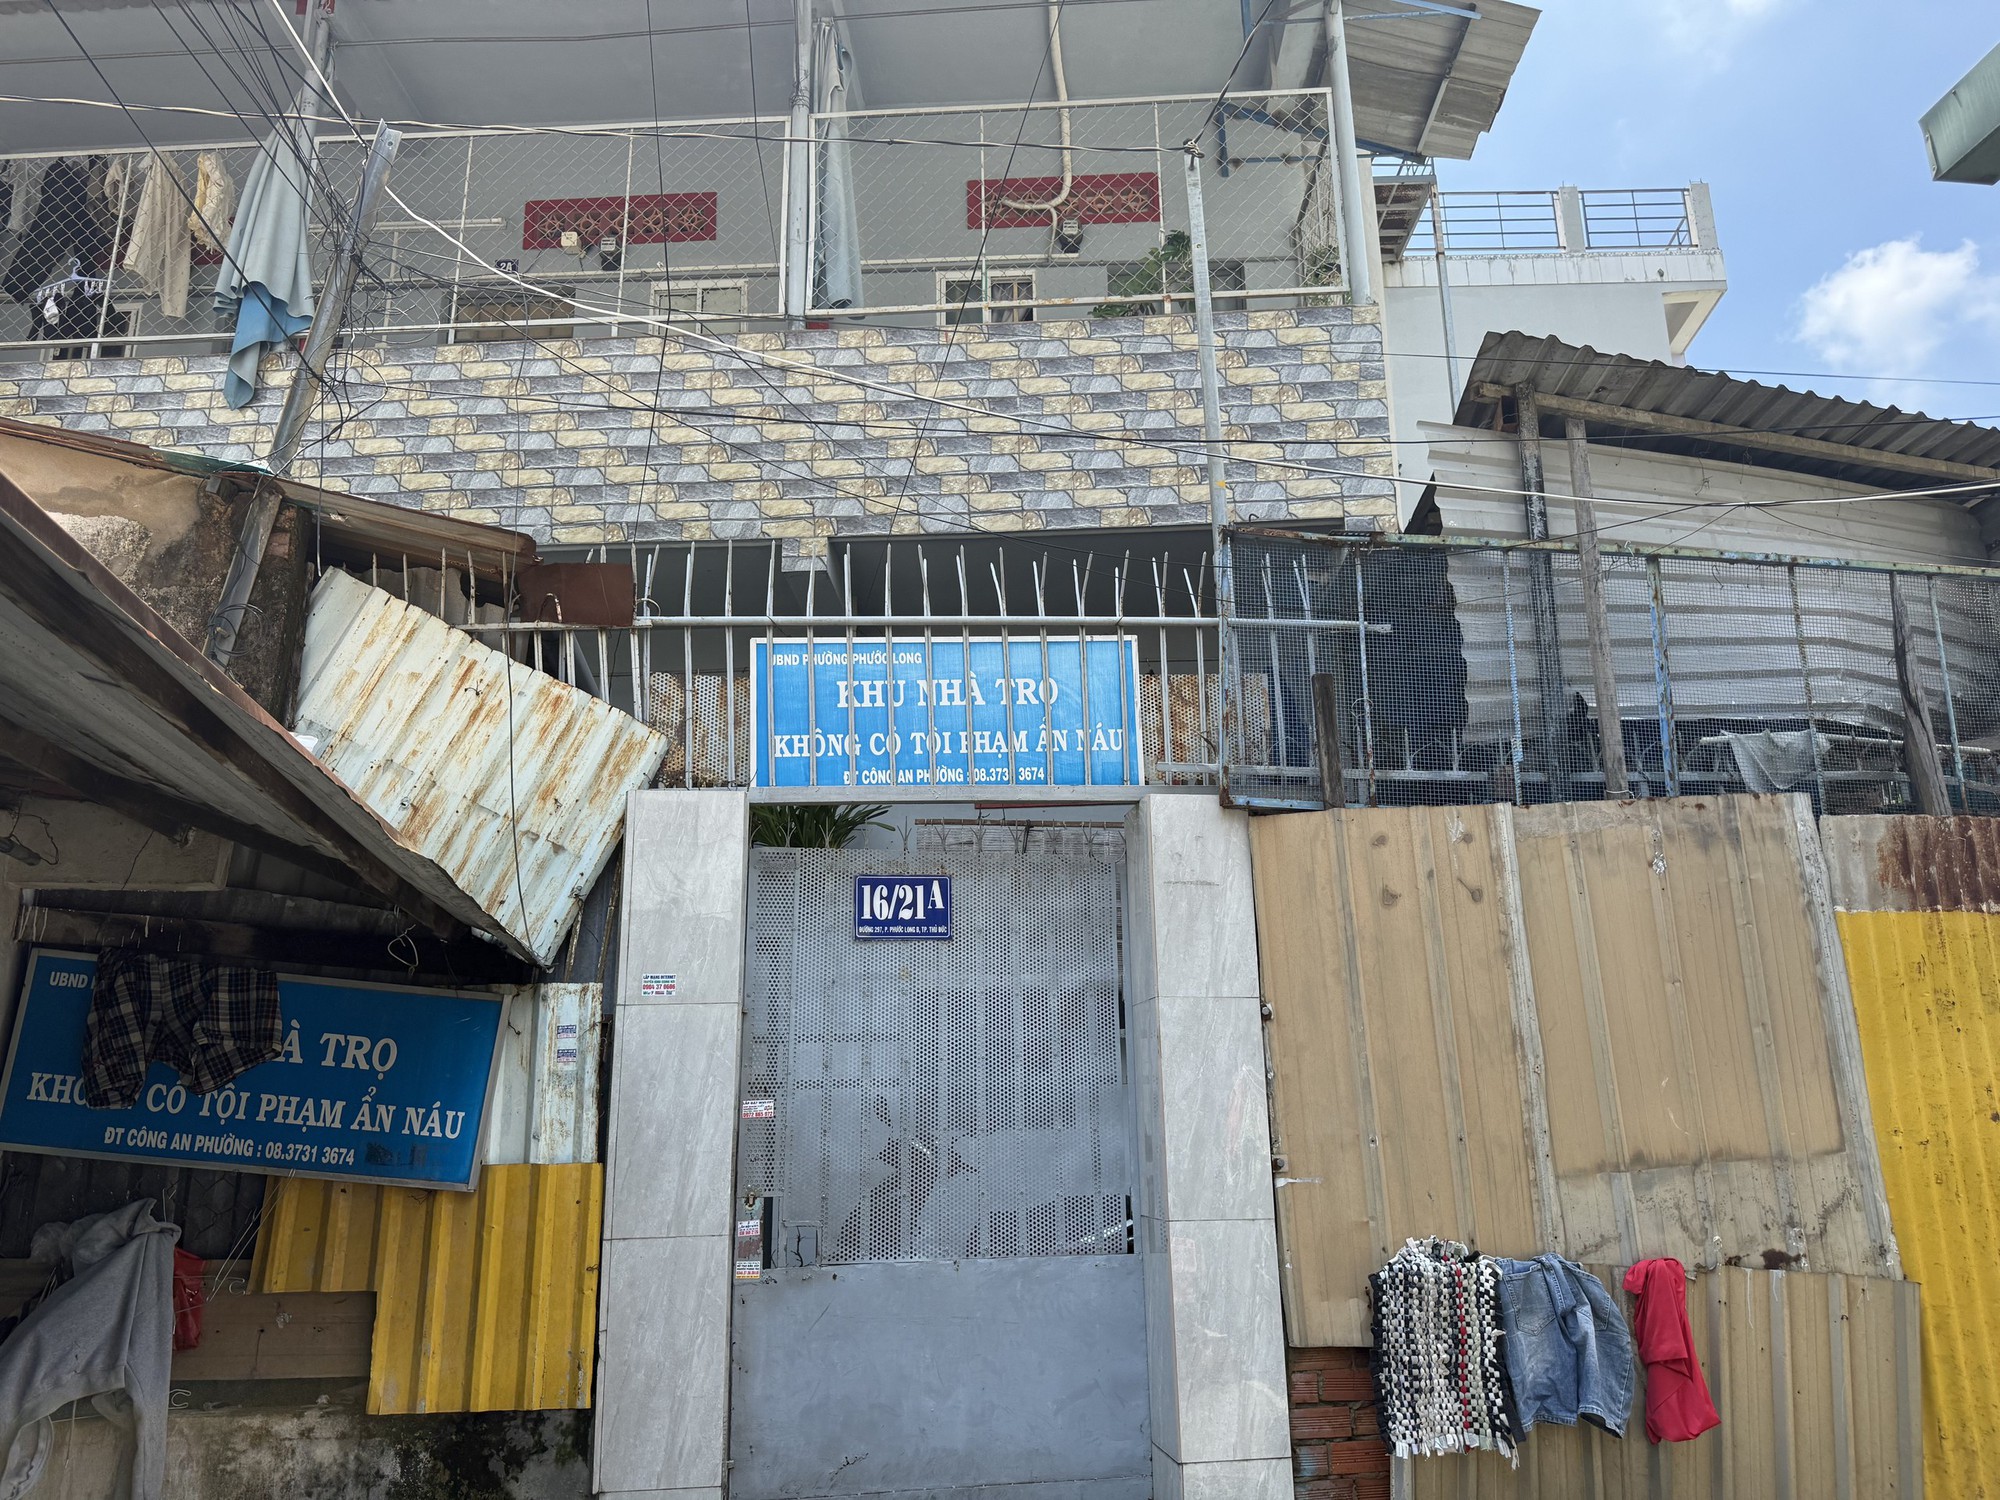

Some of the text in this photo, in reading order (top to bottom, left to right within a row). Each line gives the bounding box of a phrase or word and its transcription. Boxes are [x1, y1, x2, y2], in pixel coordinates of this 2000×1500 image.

[893, 652, 922, 664] LONG
[836, 679, 906, 708] KHU
[916, 670, 986, 706] NHÀ
[774, 727, 861, 758] KHÔNG
[897, 768, 914, 783] AN
[973, 767, 1009, 782] 08.373
[1018, 766, 1045, 781] 3674
[889, 924, 904, 933] PHƯỚC
[929, 924, 938, 933] THỦ
[938, 924, 947, 933] ĐỨC
[49, 971, 89, 989] UBND
[319, 1032, 398, 1081] TRỌ
[198, 1082, 251, 1126] TỘI
[255, 1093, 346, 1133] PHẠM
[350, 1085, 397, 1133] ẨN
[401, 1100, 466, 1140] NÁU
[103, 1126, 125, 1145] ĐT
[126, 1125, 168, 1149] CÔNG
[170, 1133, 192, 1151] AN
[193, 1132, 254, 1157] PHƯỜNG
[265, 1141, 318, 1162] 08.3731
[321, 1146, 355, 1166] 3674
